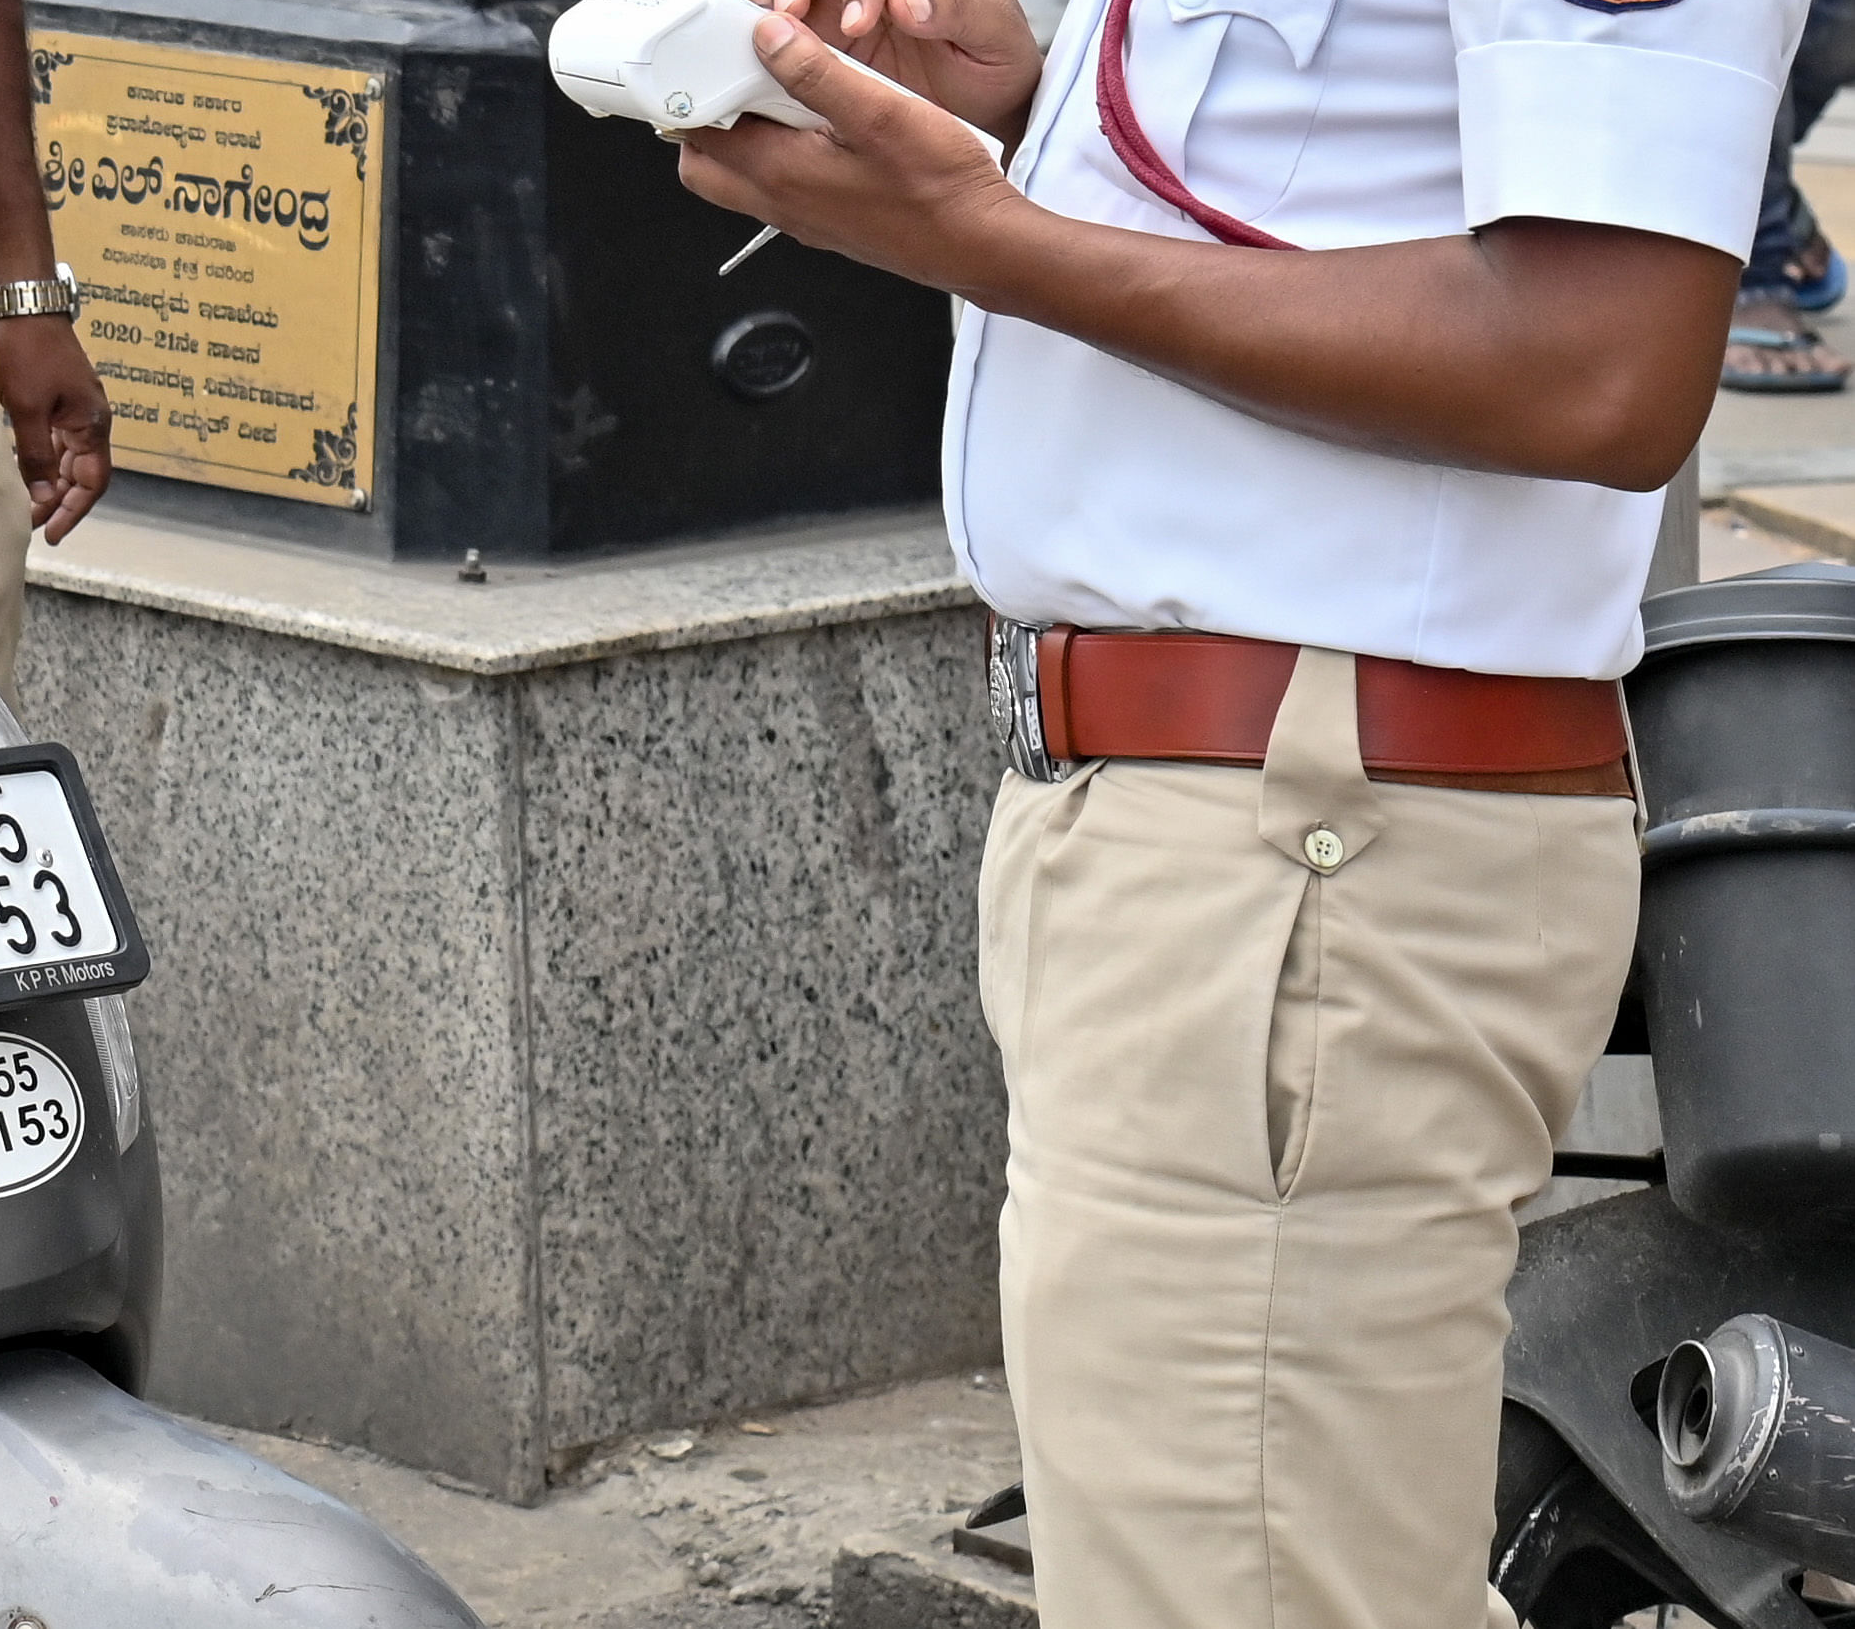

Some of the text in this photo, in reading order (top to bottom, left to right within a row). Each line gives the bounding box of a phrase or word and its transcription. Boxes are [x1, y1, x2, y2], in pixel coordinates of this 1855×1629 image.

[127, 85, 243, 113] ಕರ್ನಾಟಕ ಸರ್ಕಾರ
[43, 140, 85, 211] ಶ್ರೀ
[121, 223, 170, 242] ಶಾಸಕರು
[90, 319, 199, 354] 2020-21ನೇ
[61, 960, 116, 985] Motors
